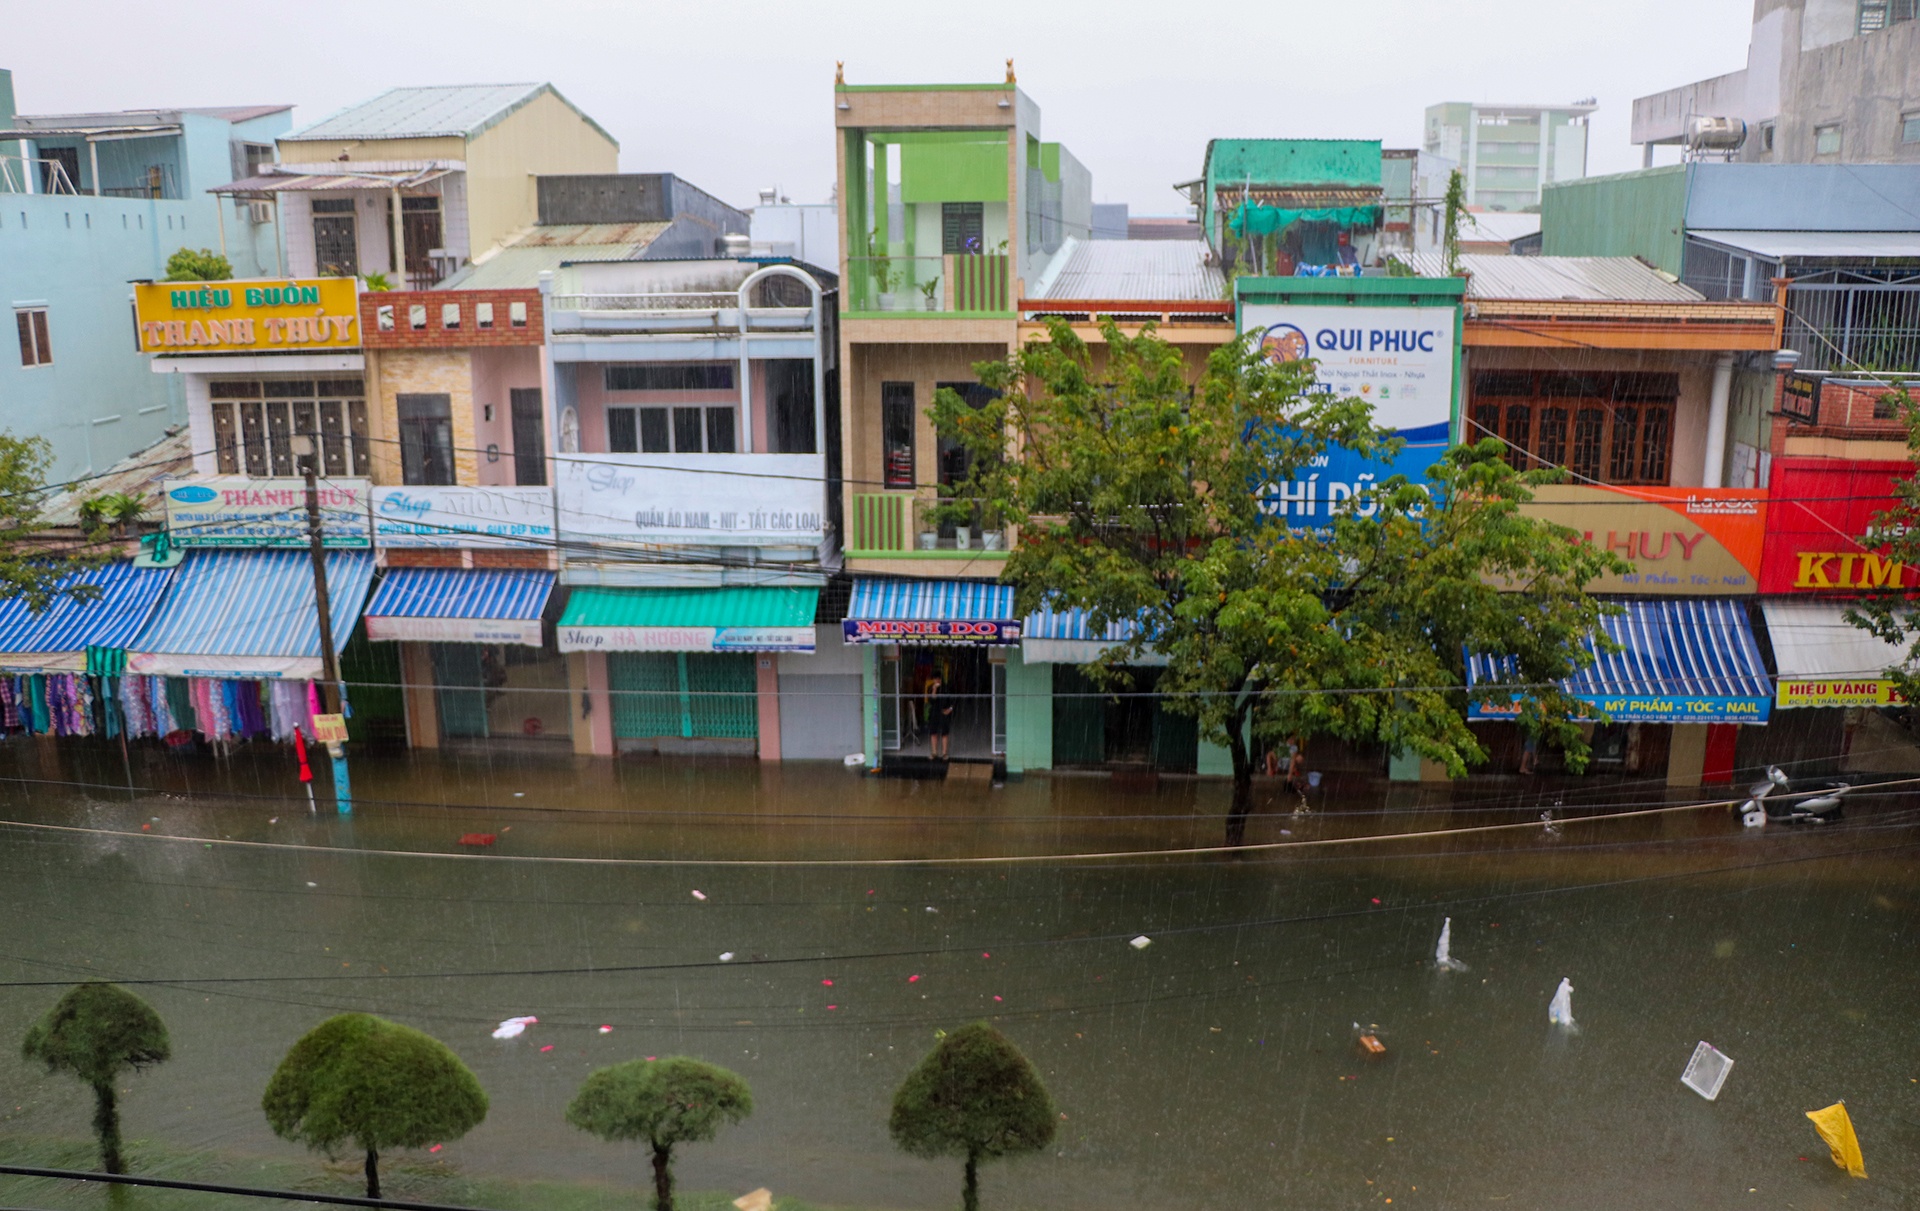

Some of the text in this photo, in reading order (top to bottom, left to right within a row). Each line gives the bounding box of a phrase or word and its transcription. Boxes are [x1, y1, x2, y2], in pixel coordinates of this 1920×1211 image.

[170, 282, 319, 312] HIỆU BUÔN
[143, 317, 256, 347] THANH
[1315, 329, 1434, 352] QUI PHUC
[1349, 357, 1398, 366] FURNITURE
[221, 489, 295, 506] THANH
[1256, 473, 1319, 516] CHÍ
[685, 510, 710, 529] NAM
[1606, 530, 1706, 560] HUY
[1690, 573, 1709, 585] Tóc
[1721, 574, 1747, 586] Nail
[1794, 552, 1905, 589] KIM
[856, 620, 941, 635] MINH
[950, 621, 998, 635] DO
[563, 630, 604, 648] Shop
[1789, 682, 1827, 698] HIỆU
[1833, 680, 1878, 695] VÀNG
[1630, 697, 1674, 713] PHẨM
[1726, 701, 1760, 713] NAIL
